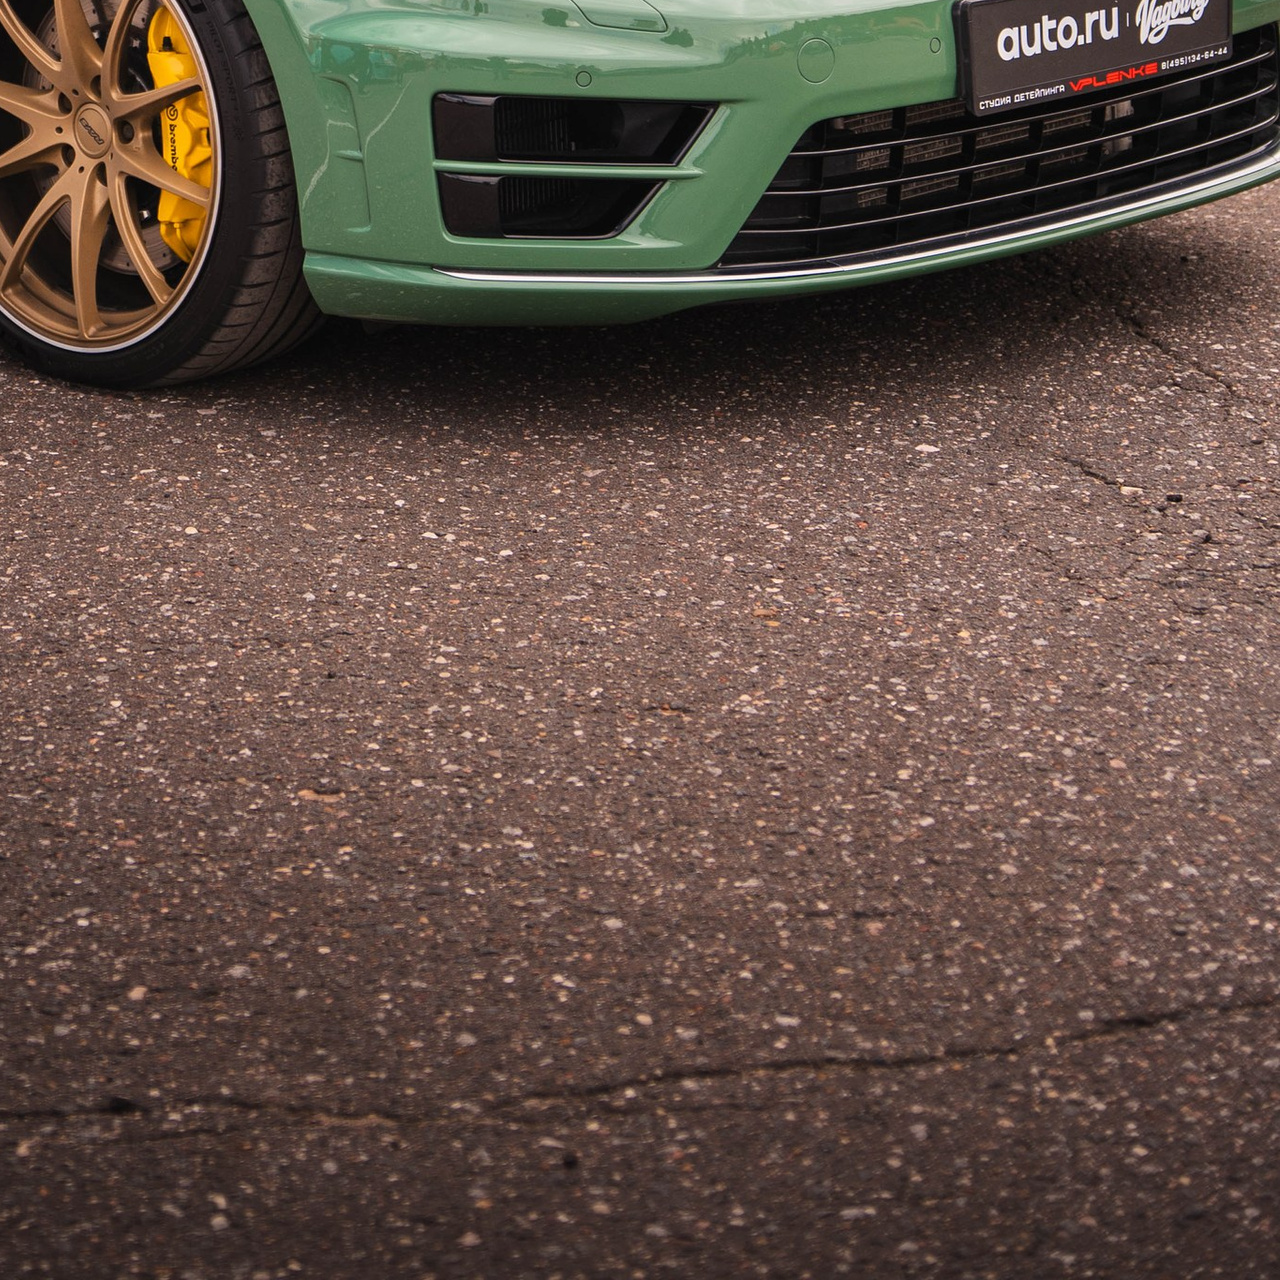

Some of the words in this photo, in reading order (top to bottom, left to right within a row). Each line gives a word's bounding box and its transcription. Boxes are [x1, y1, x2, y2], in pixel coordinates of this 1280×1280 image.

[996, 6, 1119, 61] auto.ru
[979, 95, 1012, 110] СТУДИЯ
[1014, 84, 1066, 103] ДЕТЕЙЛИНГА
[1069, 62, 1158, 92] VPLENKE
